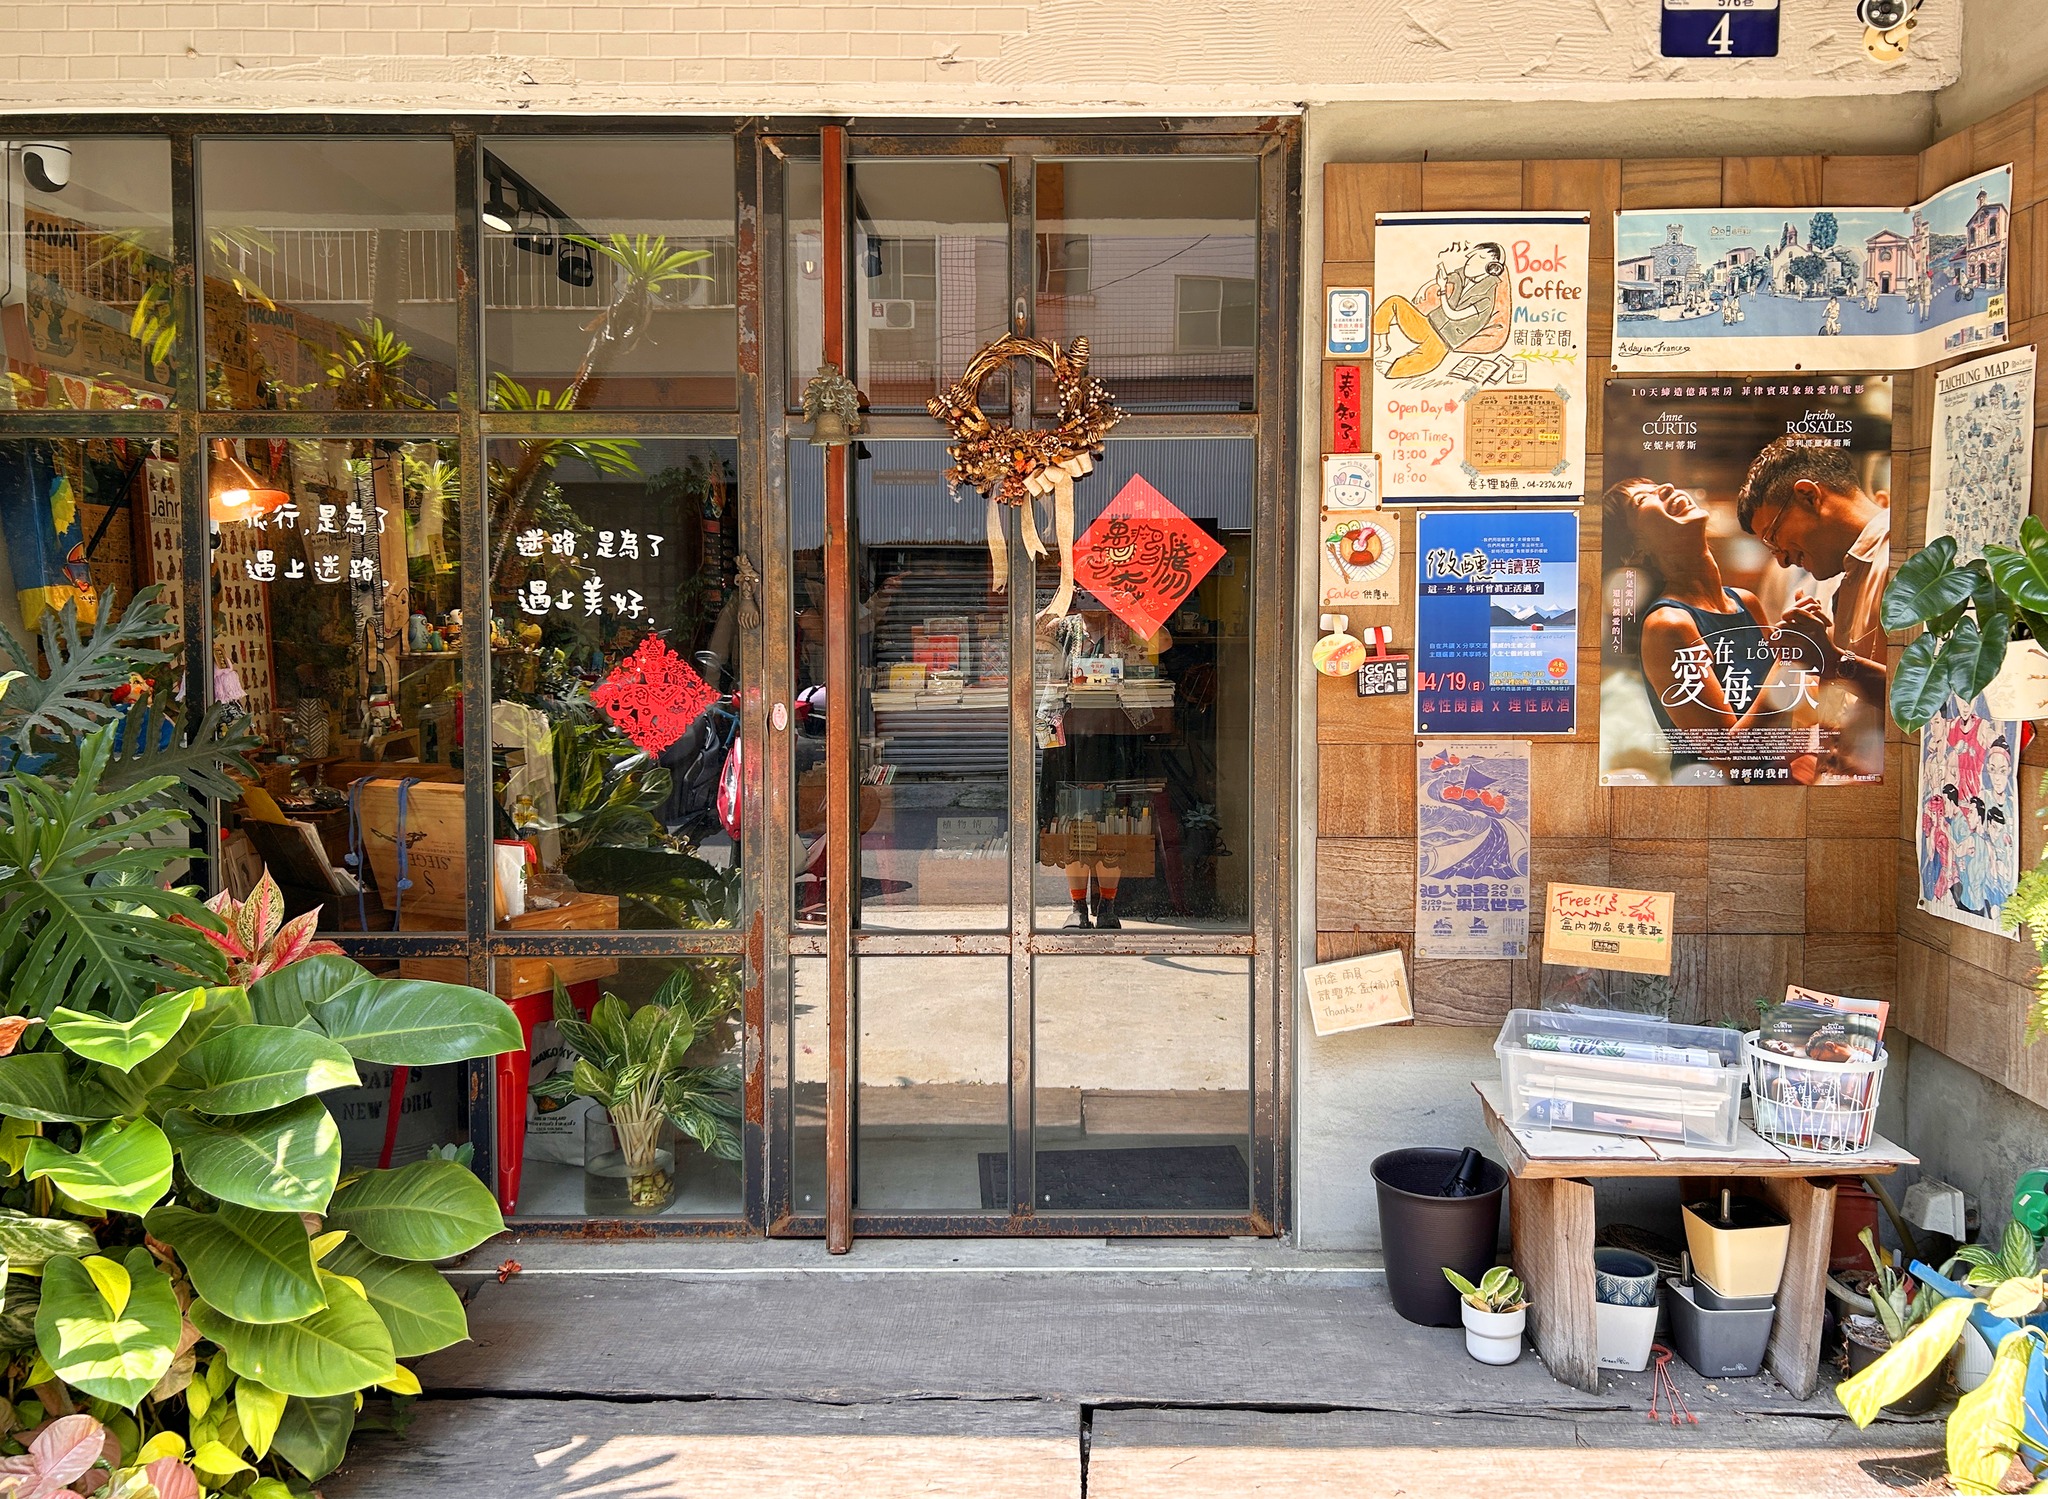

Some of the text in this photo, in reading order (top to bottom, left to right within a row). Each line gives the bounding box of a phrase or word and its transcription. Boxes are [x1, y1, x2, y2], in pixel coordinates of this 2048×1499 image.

[1707, 12, 1734, 55] 4
[1513, 240, 1567, 273] Book
[1518, 276, 1582, 299] Coffee
[1514, 306, 1567, 323] Music
[1939, 368, 1980, 391] TAICHUNG
[1984, 361, 2010, 377] MAP
[1388, 400, 1444, 420] Open Day
[1656, 411, 1683, 422] Anne
[1803, 409, 1836, 422] Jericho
[1642, 422, 1697, 435] CURTIS
[1786, 420, 1853, 434] ROSALES
[1388, 429, 1448, 443] Open Time
[1392, 449, 1427, 460] 13:00
[1392, 473, 1427, 484] 18:00
[1490, 558, 1541, 575] 共讀聚
[1326, 587, 1360, 600] Cake
[1757, 638, 1769, 647] the
[1746, 648, 1804, 660] LOVED
[1424, 672, 1467, 692] 4/19
[1422, 698, 1484, 714] 感性閱讀
[1508, 698, 1570, 713] 理性飲酒
[342, 1090, 433, 1121] NEW ORK
